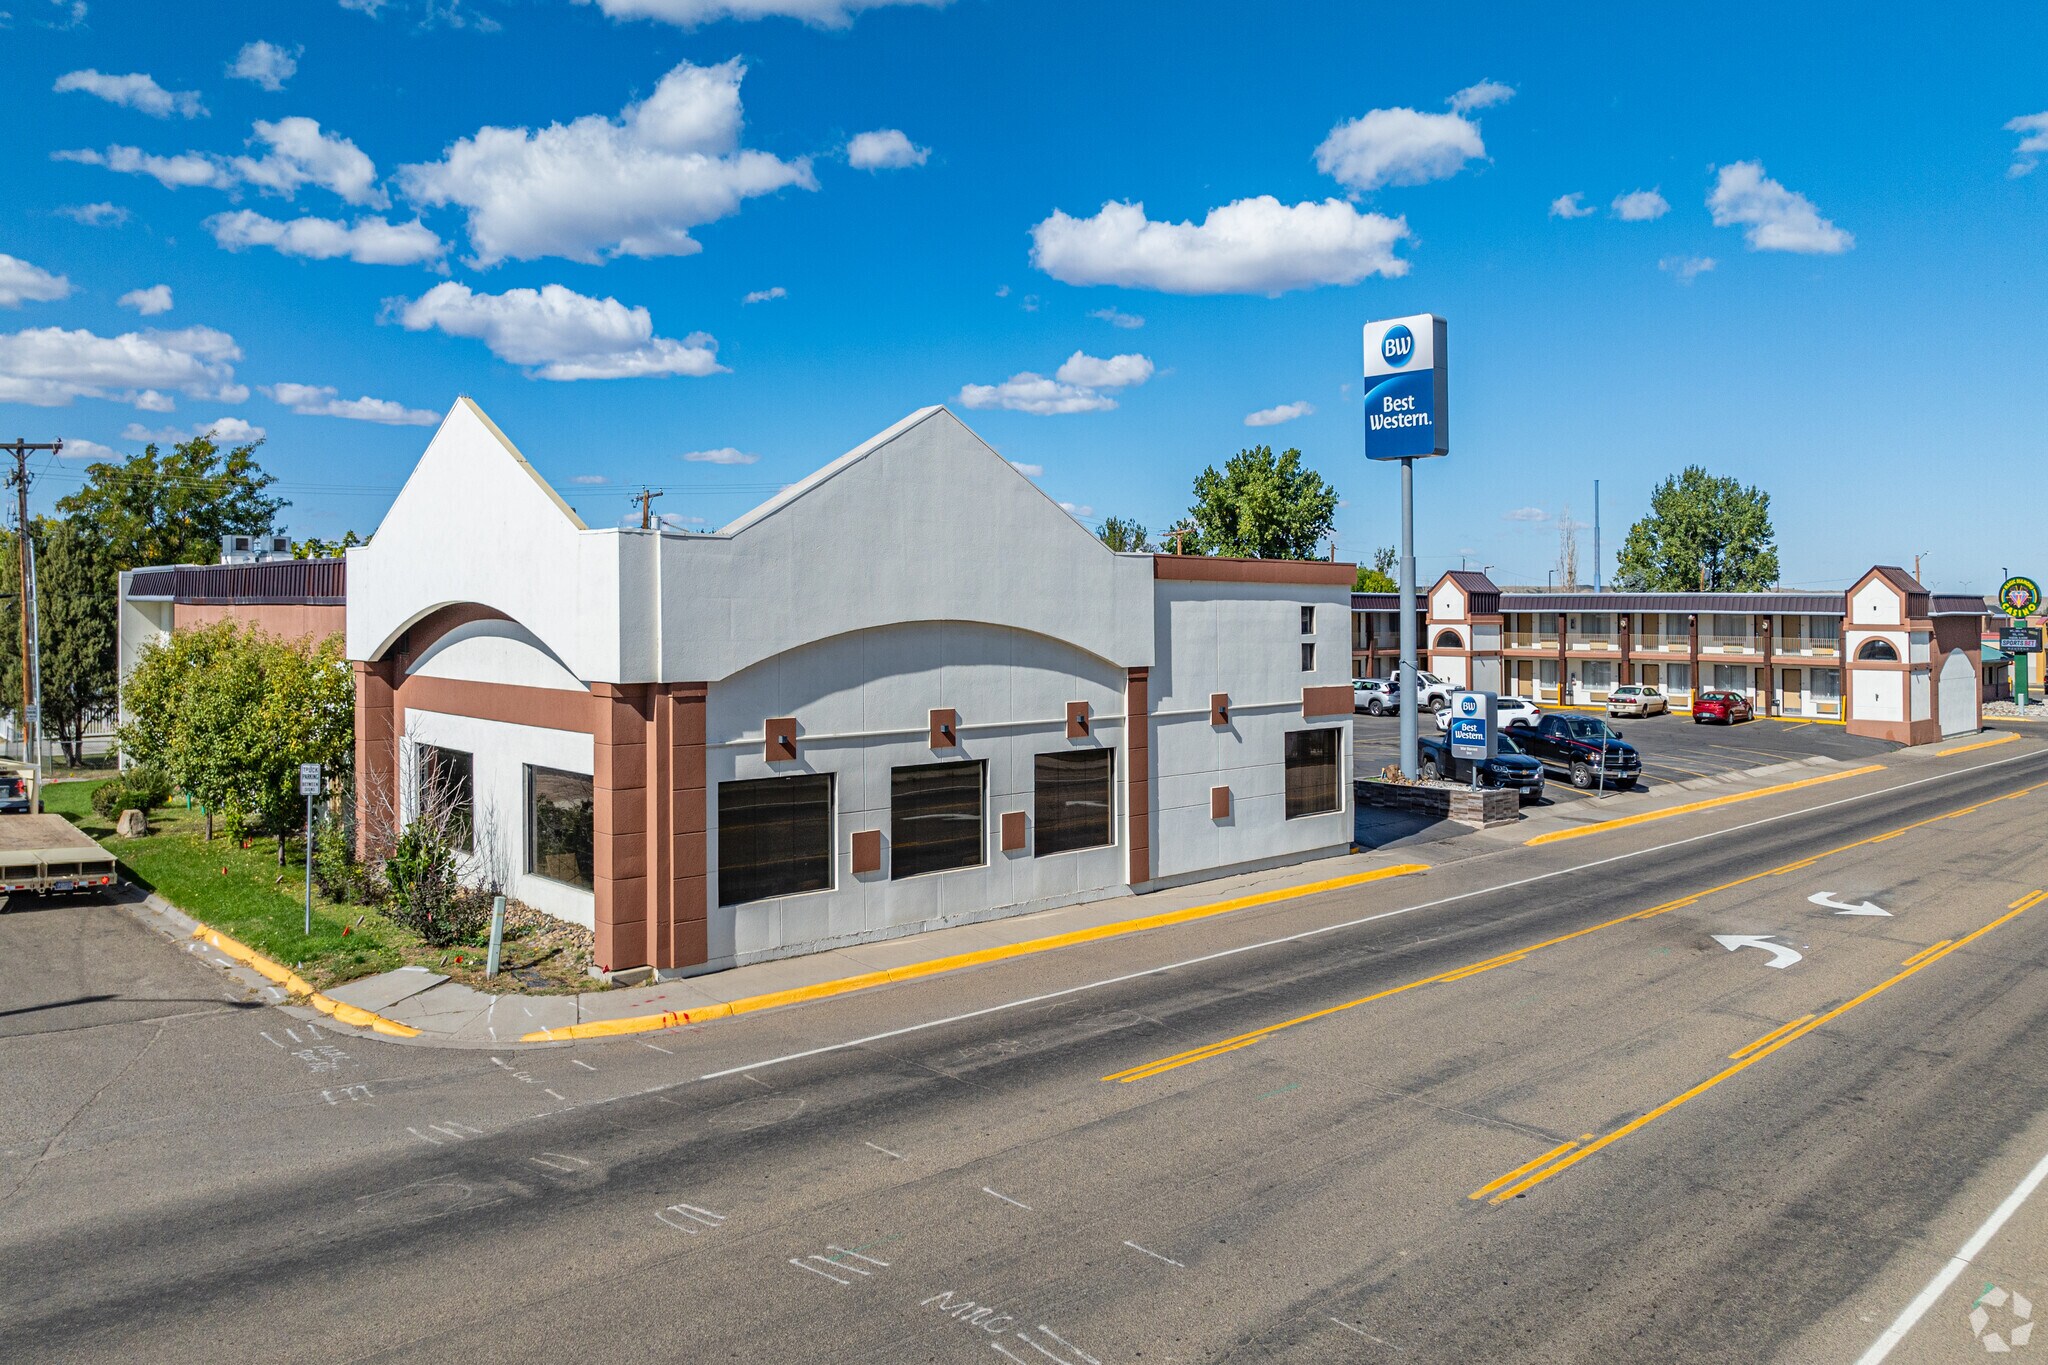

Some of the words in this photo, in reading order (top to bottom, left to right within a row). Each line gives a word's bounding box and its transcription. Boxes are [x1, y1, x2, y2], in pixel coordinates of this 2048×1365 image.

[1385, 336, 1411, 357] BW
[1383, 395, 1415, 412] Best
[2001, 602, 2036, 617] CASINO
[1463, 702, 1475, 711] BW
[1461, 723, 1477, 732] Best
